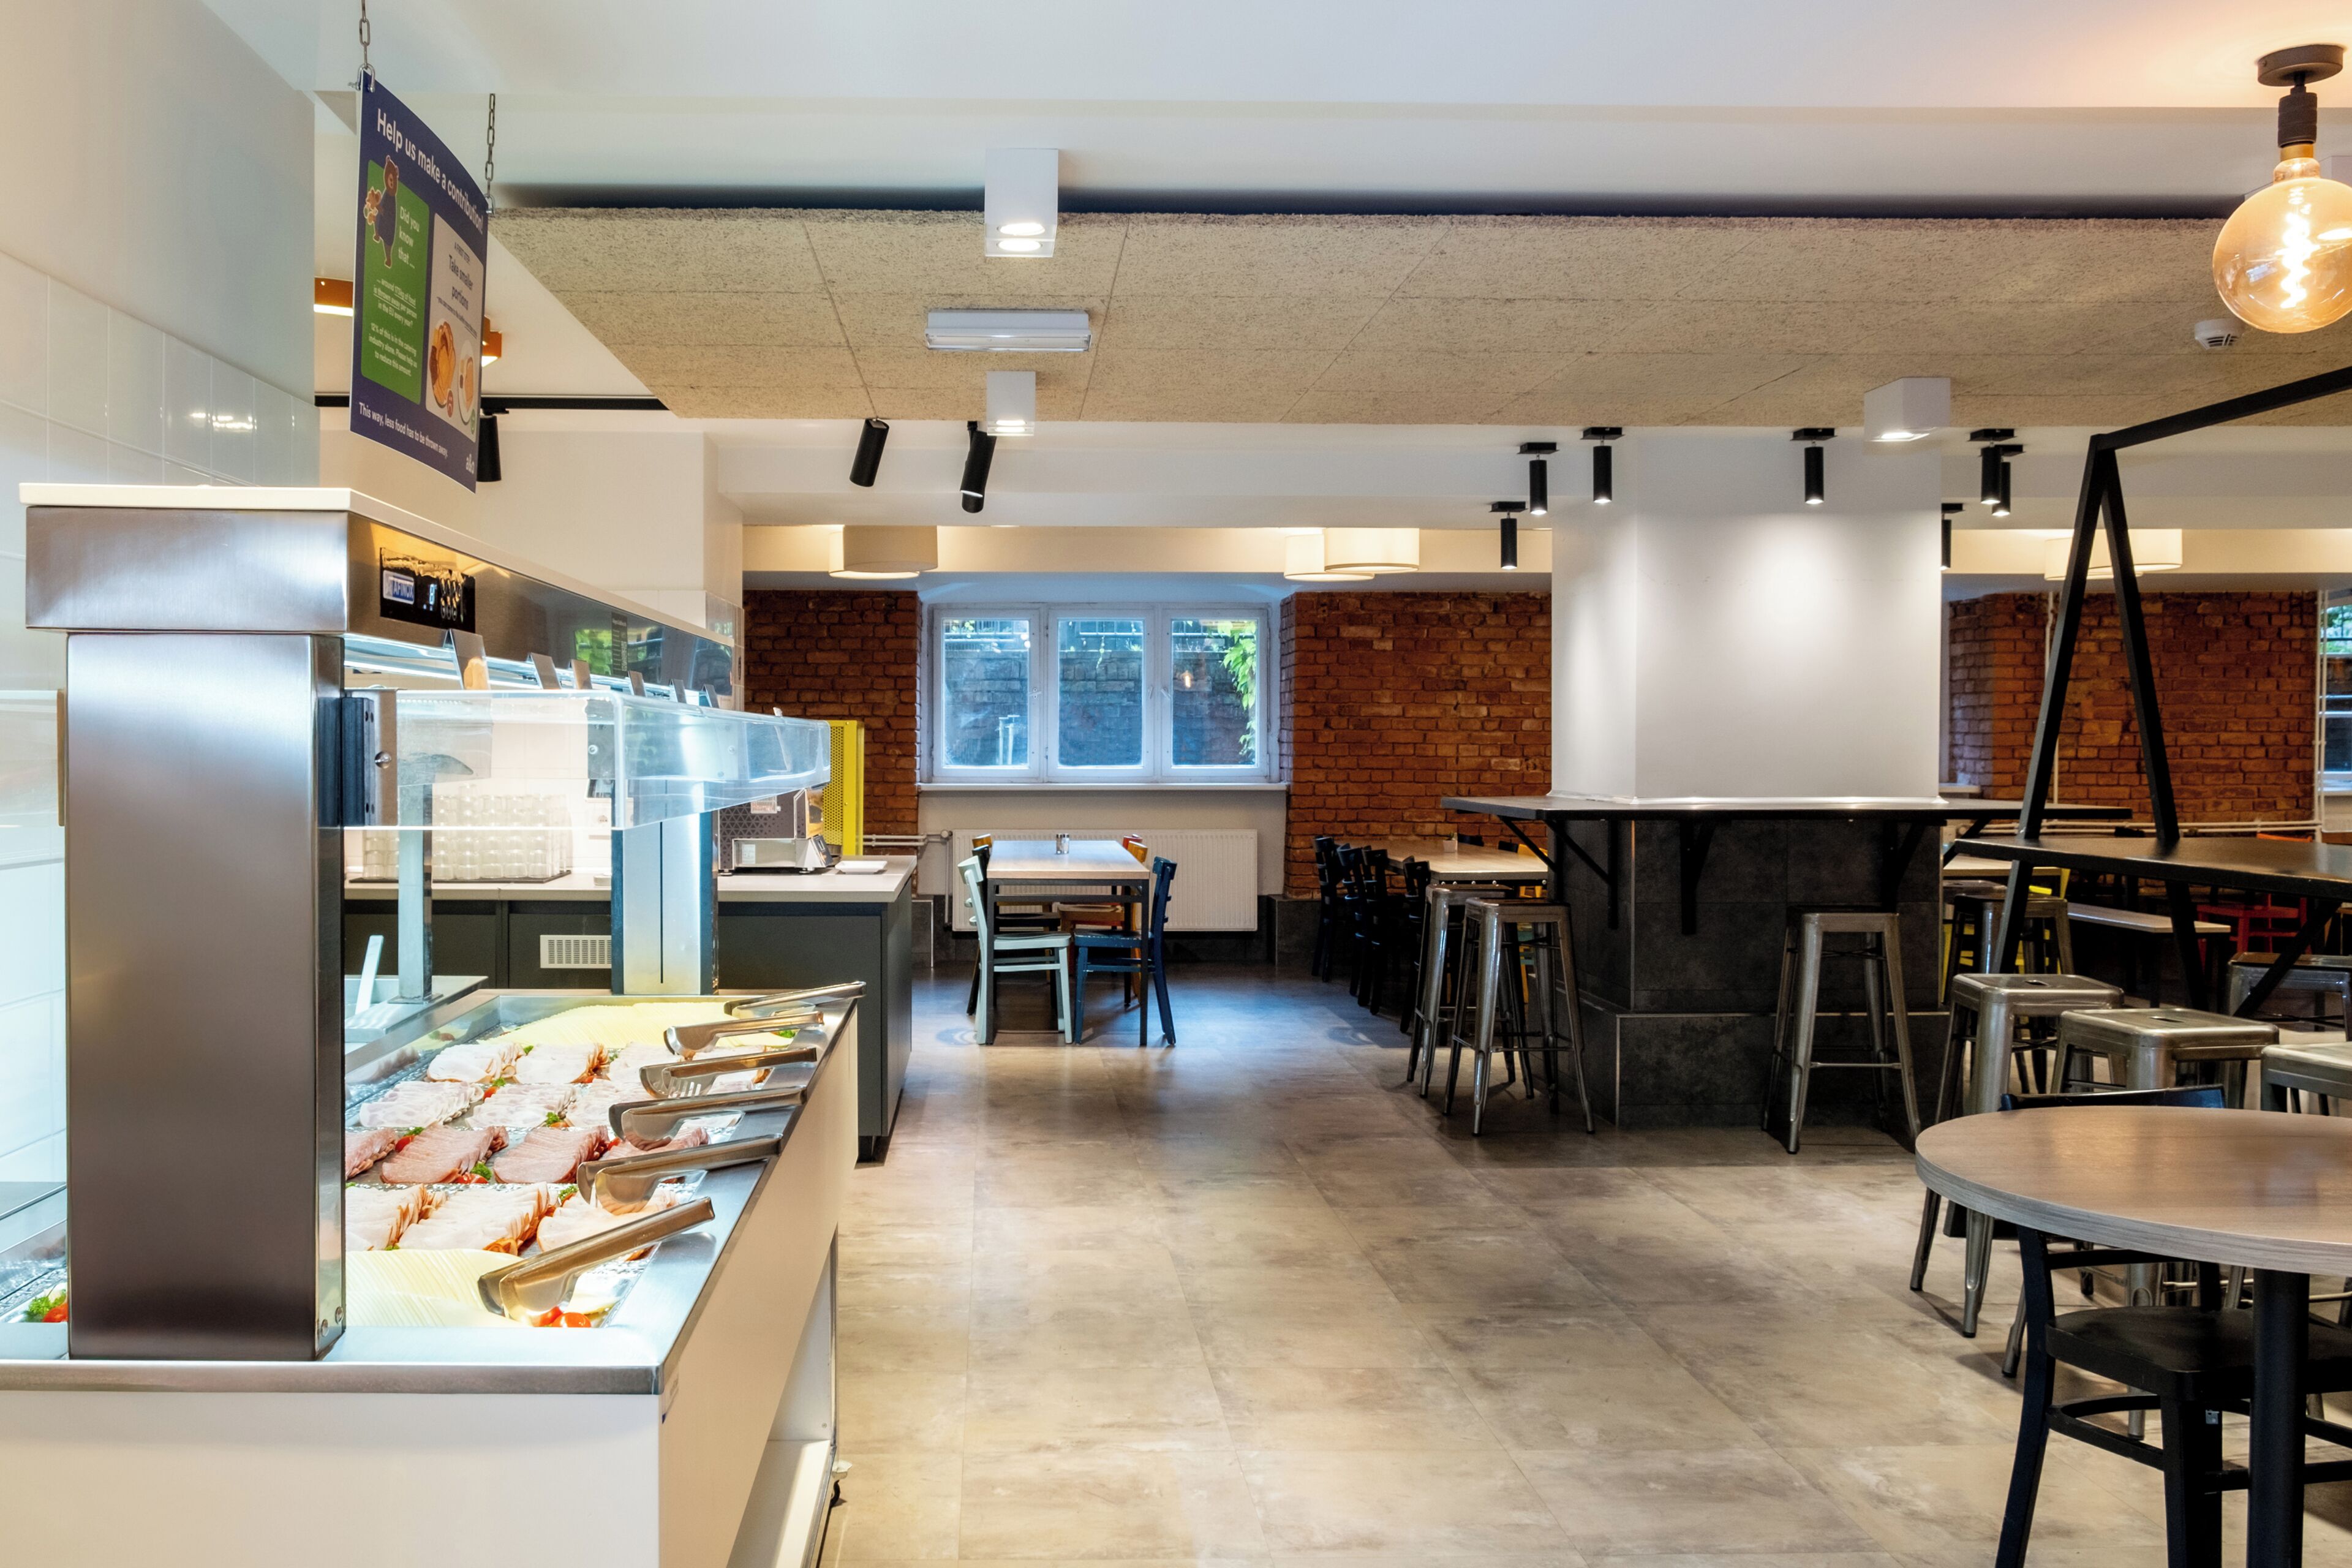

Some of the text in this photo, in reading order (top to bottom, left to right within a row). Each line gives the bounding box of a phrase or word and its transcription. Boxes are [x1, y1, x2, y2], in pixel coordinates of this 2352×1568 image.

[377, 108, 483, 235] Help us make a contribution!
[400, 206, 420, 232] Did you
[399, 225, 413, 247] know
[398, 247, 409, 265] that
[449, 254, 473, 291] Take smaller
[374, 284, 377, 294] is
[377, 287, 391, 302] thrown
[391, 298, 400, 309] away
[406, 306, 417, 319] person
[381, 279, 394, 292] around
[405, 292, 409, 301] of
[451, 286, 469, 311] portions
[378, 300, 382, 309] in
[389, 306, 394, 317] EU
[394, 311, 404, 325] every
[369, 334, 385, 350] industry
[396, 348, 407, 362] Please
[379, 327, 384, 336] of
[404, 342, 417, 357] catering
[375, 350, 379, 359] to
[379, 353, 392, 366] reduce
[359, 402, 371, 418] This
[372, 411, 384, 427] way,
[385, 414, 394, 429] less
[395, 418, 405, 435] food
[415, 430, 419, 442] to
[420, 431, 424, 445] be
[425, 434, 439, 452] thrown
[439, 446, 448, 459] away.
[466, 453, 475, 475] a&o
[393, 579, 414, 600] AFINOX
